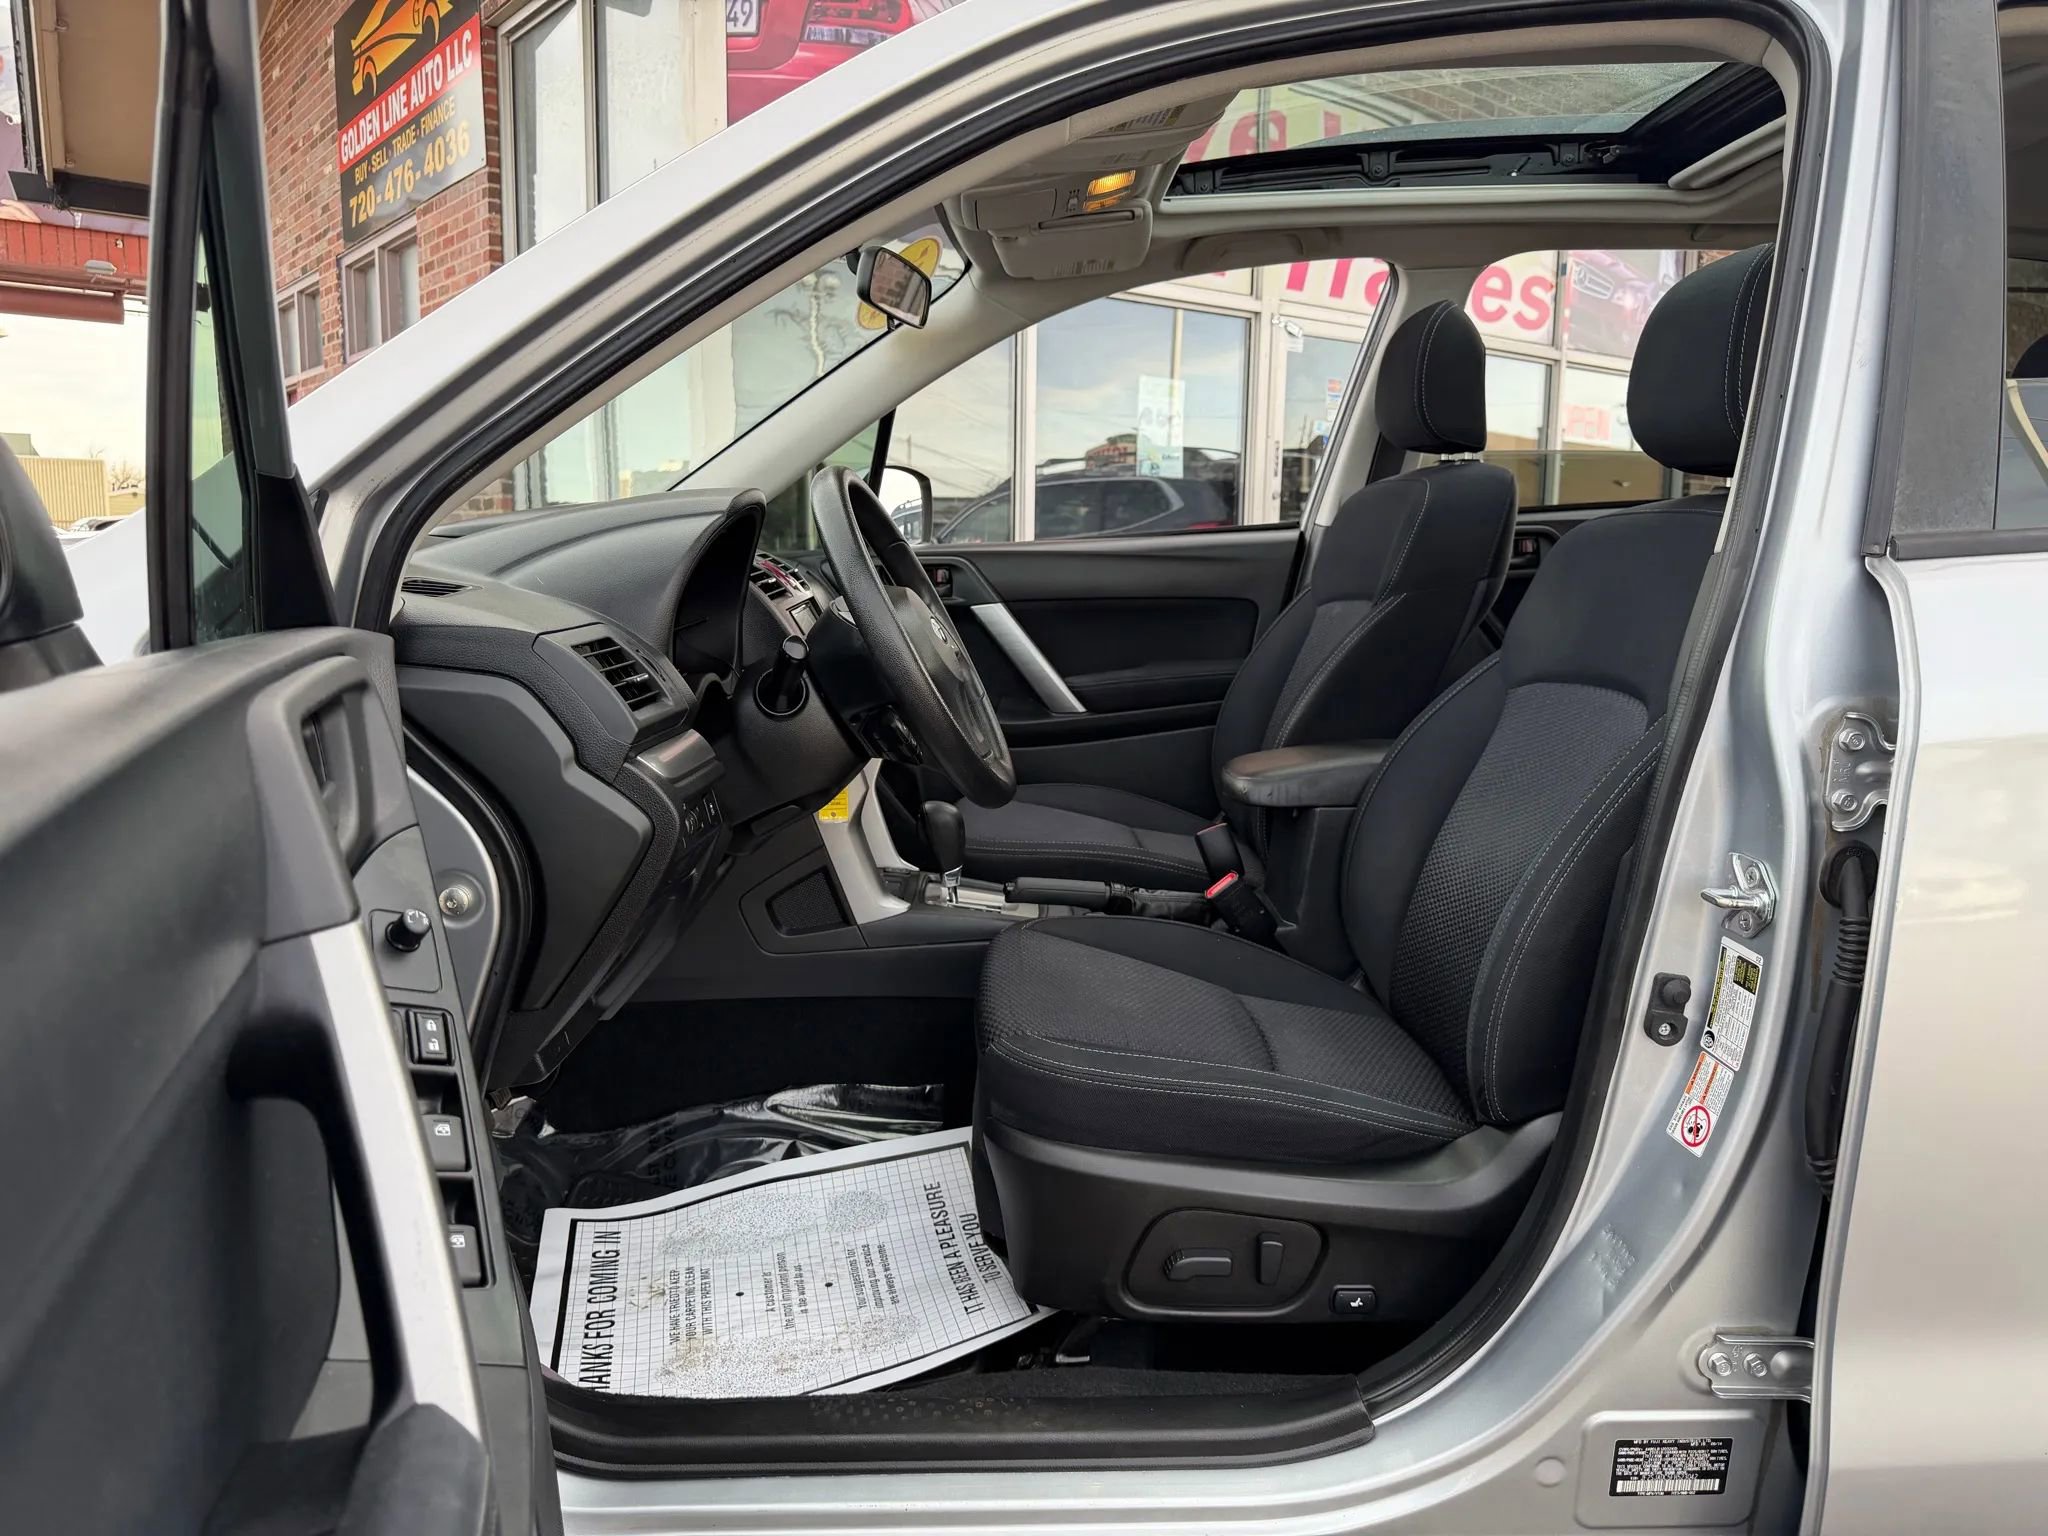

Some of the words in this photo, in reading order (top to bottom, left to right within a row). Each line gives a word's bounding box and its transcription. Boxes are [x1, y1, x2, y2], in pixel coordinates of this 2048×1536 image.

[341, 109, 381, 165] GOLDEN
[382, 84, 408, 132] LINE
[410, 53, 443, 112] AUTO
[446, 29, 473, 82] LLC
[355, 160, 369, 186] BUY
[371, 147, 389, 174] SELL
[392, 128, 417, 160] TRADE
[420, 96, 456, 138] FINANCE
[923, 1181, 958, 1250] PLEASURE
[959, 1213, 981, 1240] YOU
[594, 1231, 622, 1244] IN
[944, 1250, 962, 1259] A
[968, 1240, 997, 1272] SERVE
[587, 1249, 621, 1304] COMING
[947, 1261, 972, 1283] BEEN
[985, 1271, 1003, 1283] TO
[956, 1283, 980, 1303] HAS
[701, 1300, 712, 1315] THIS
[963, 1302, 985, 1315] IT
[584, 1308, 616, 1340] FOR
[670, 1314, 680, 1330] HAVE
[701, 1317, 713, 1335] WITH
[579, 1343, 615, 1390] ANKS
